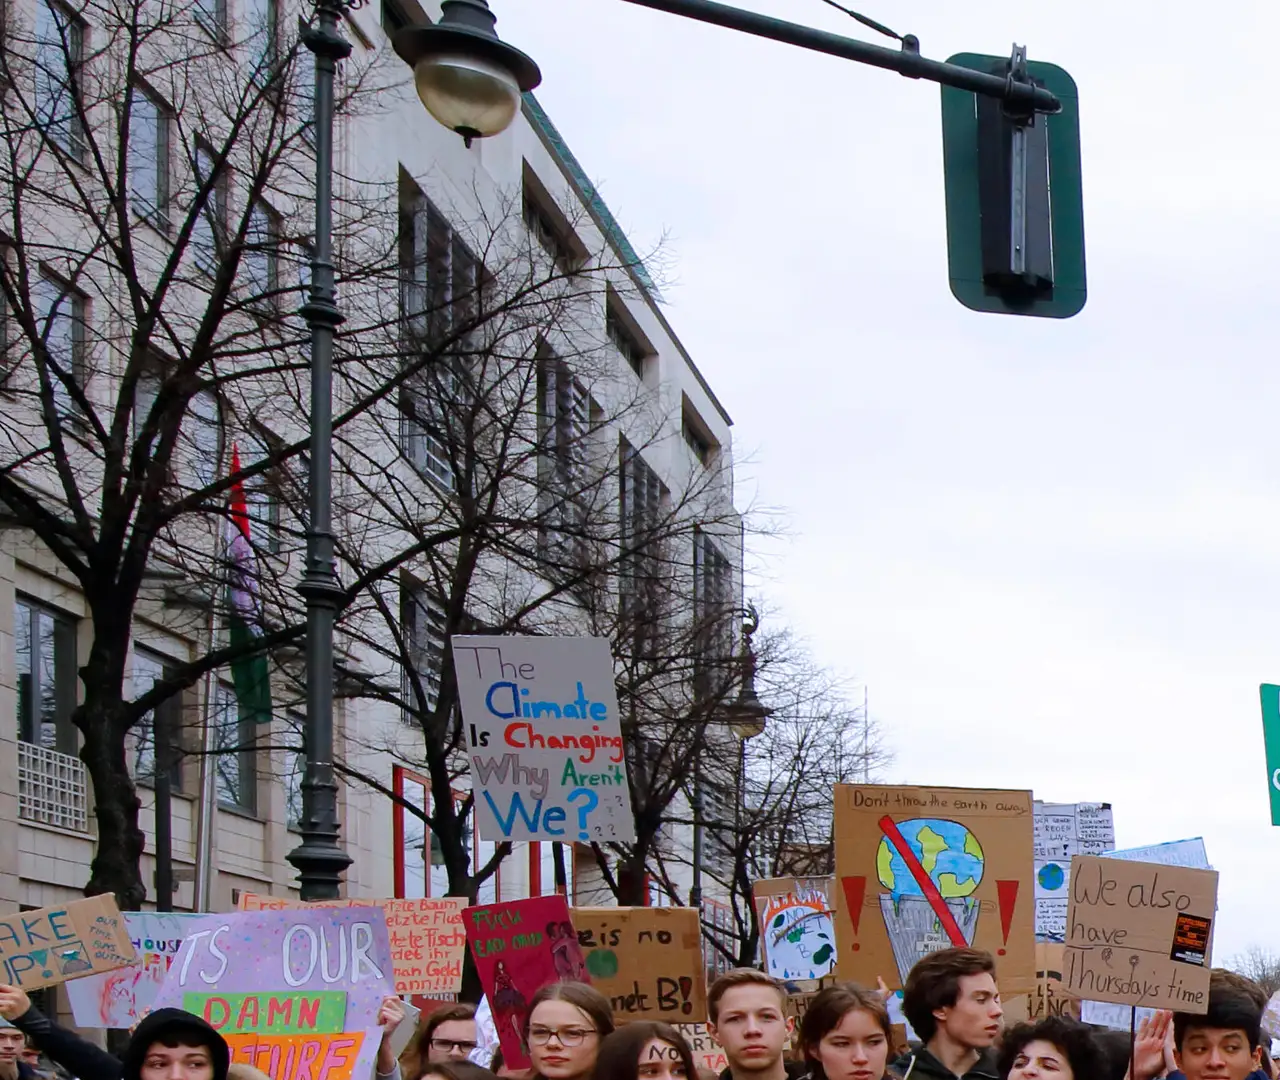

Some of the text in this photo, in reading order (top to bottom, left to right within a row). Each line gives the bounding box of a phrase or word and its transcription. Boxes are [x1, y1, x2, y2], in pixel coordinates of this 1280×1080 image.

[454, 646, 535, 680] The
[485, 681, 607, 721] Climate
[470, 722, 624, 763] Is Changing
[473, 753, 626, 800] Why Aren't
[482, 788, 598, 840] We?
[854, 790, 890, 807] Don't
[954, 801, 988, 810] earth
[419, 899, 458, 910] Baum
[1074, 863, 1191, 911] We also
[0, 911, 76, 949] AKE
[600, 923, 622, 946] is
[638, 929, 672, 945] no
[1071, 906, 1128, 945] have
[282, 922, 385, 987] OUR
[395, 978, 454, 992] ann!!!
[656, 976, 693, 1015] B!
[1167, 969, 1204, 1005] time
[203, 997, 321, 1031] DAMN
[649, 1045, 681, 1061] NO
